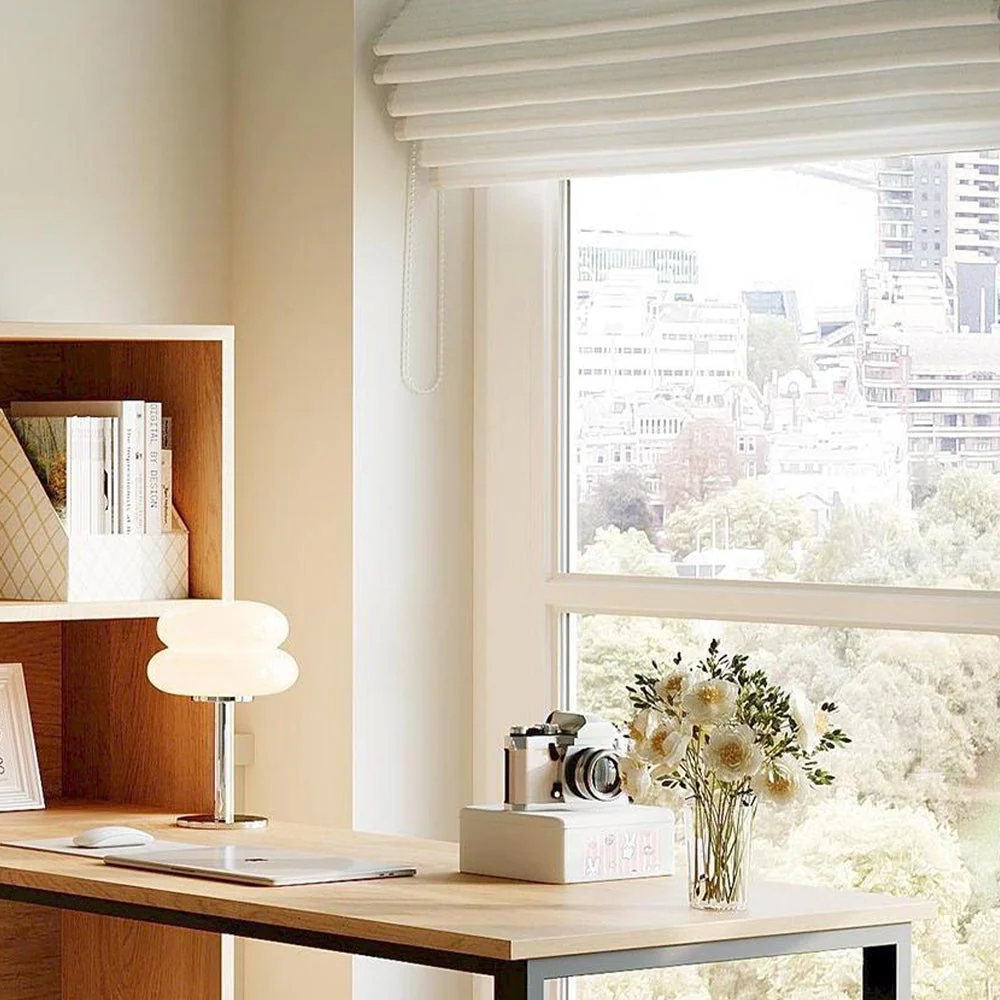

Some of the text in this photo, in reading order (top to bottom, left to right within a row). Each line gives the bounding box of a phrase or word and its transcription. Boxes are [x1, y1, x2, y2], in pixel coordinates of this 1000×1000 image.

[150, 404, 158, 509] DIGITAL BY DESIGN
